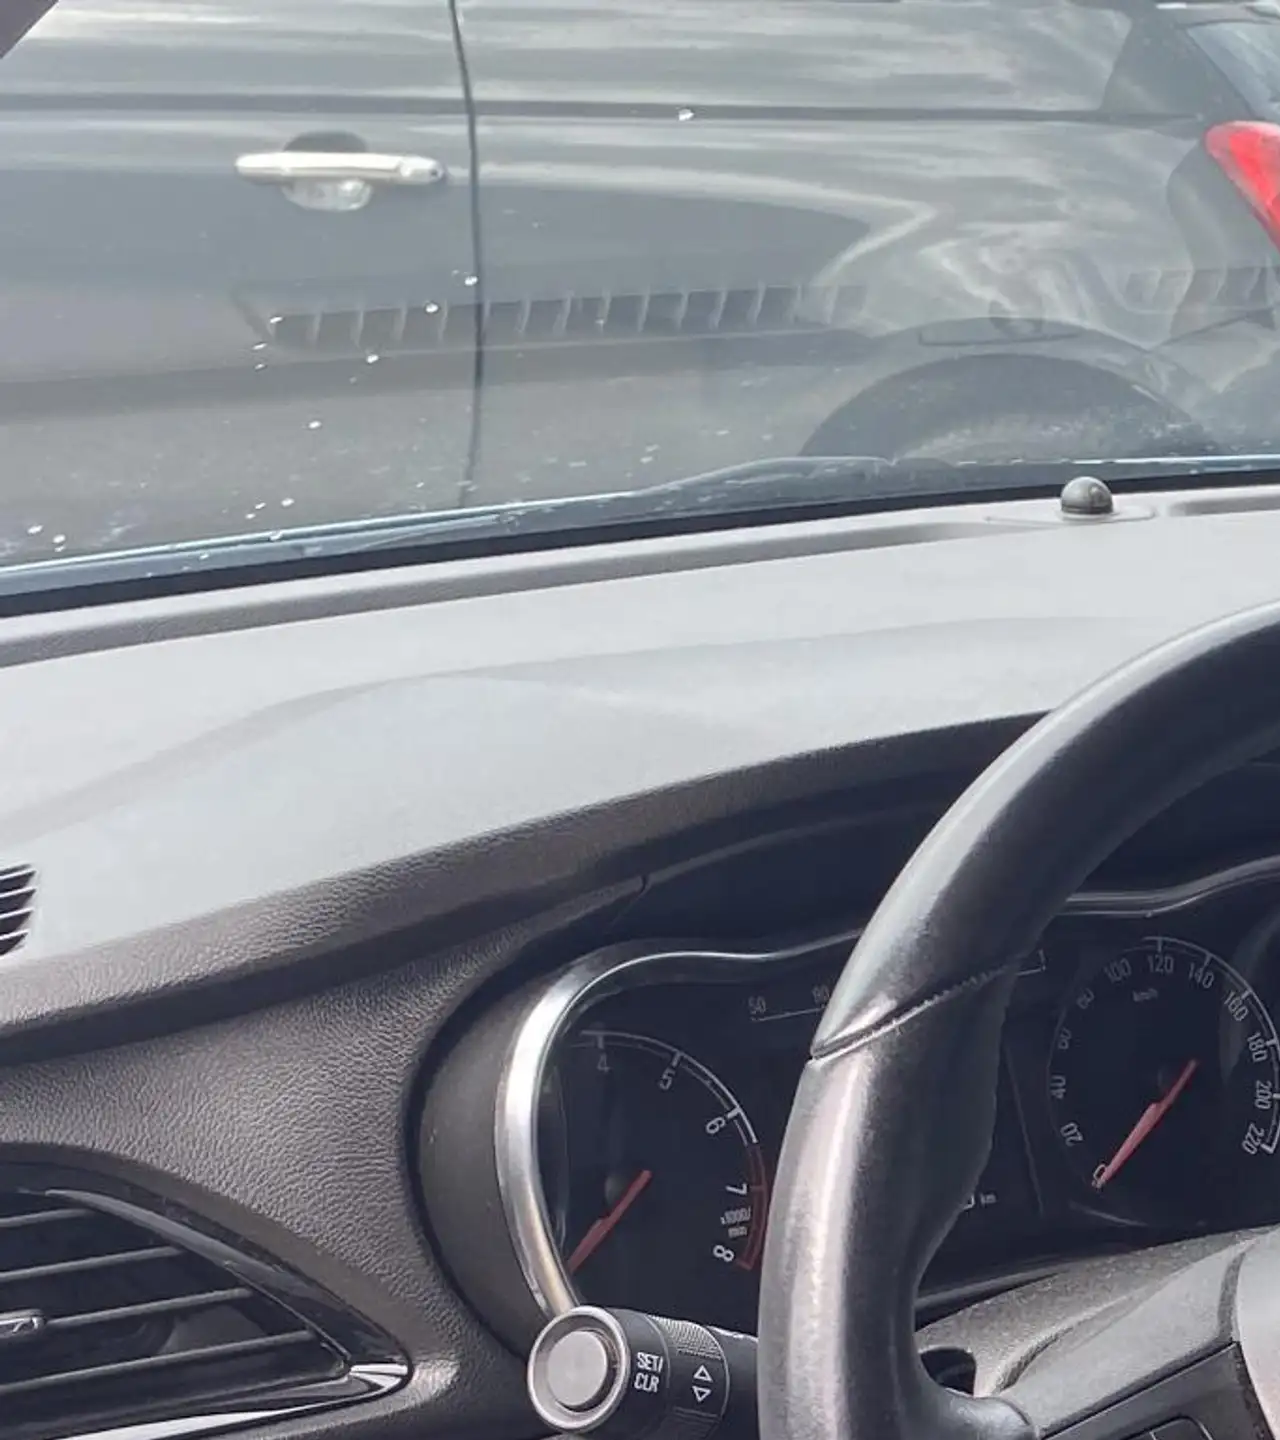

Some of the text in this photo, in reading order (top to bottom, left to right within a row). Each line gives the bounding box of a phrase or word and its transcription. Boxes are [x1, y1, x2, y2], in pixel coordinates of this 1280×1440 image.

[1104, 957, 1132, 983] 100
[1148, 955, 1174, 974] 120
[1187, 963, 1215, 989] 140
[1223, 991, 1249, 1022] 160
[1246, 1031, 1268, 1063] 180
[596, 1052, 610, 1073] 4
[658, 1069, 677, 1091] 5
[1050, 1074, 1067, 1100] 40
[1254, 1079, 1273, 1111] 200
[705, 1116, 727, 1135] 6
[1059, 1121, 1084, 1147] 20
[1241, 1122, 1265, 1155] 220
[725, 1182, 748, 1196] 7
[712, 1244, 735, 1262] 8
[633, 1372, 661, 1394] CLR
